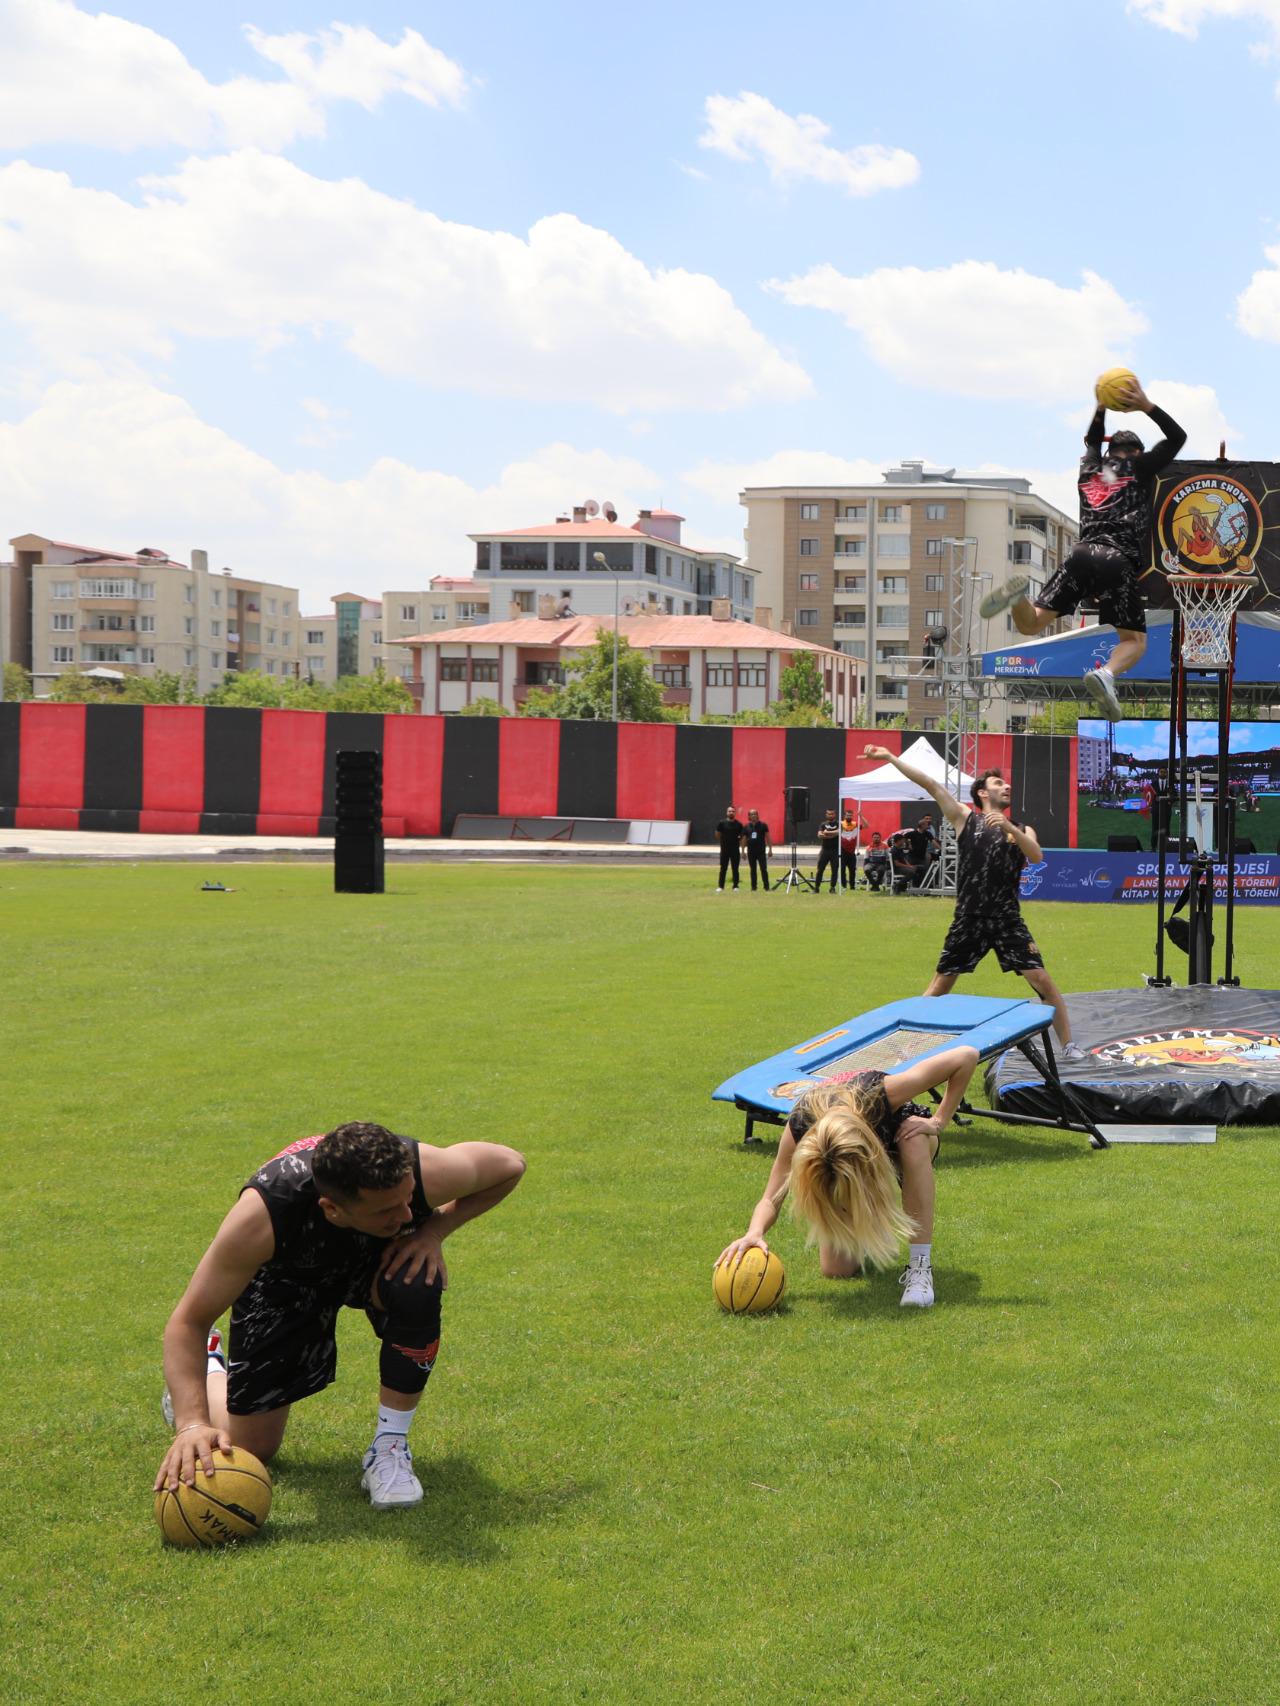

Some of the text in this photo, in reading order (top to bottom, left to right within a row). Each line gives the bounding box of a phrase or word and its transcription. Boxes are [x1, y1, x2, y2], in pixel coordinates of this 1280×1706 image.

[1220, 482, 1249, 503] SHOW
[995, 656, 1022, 665] SPOR
[1241, 876, 1276, 887] TÖRENİ
[1121, 888, 1150, 898] KİTAP
[1244, 887, 1280, 898] TÖRENİ
